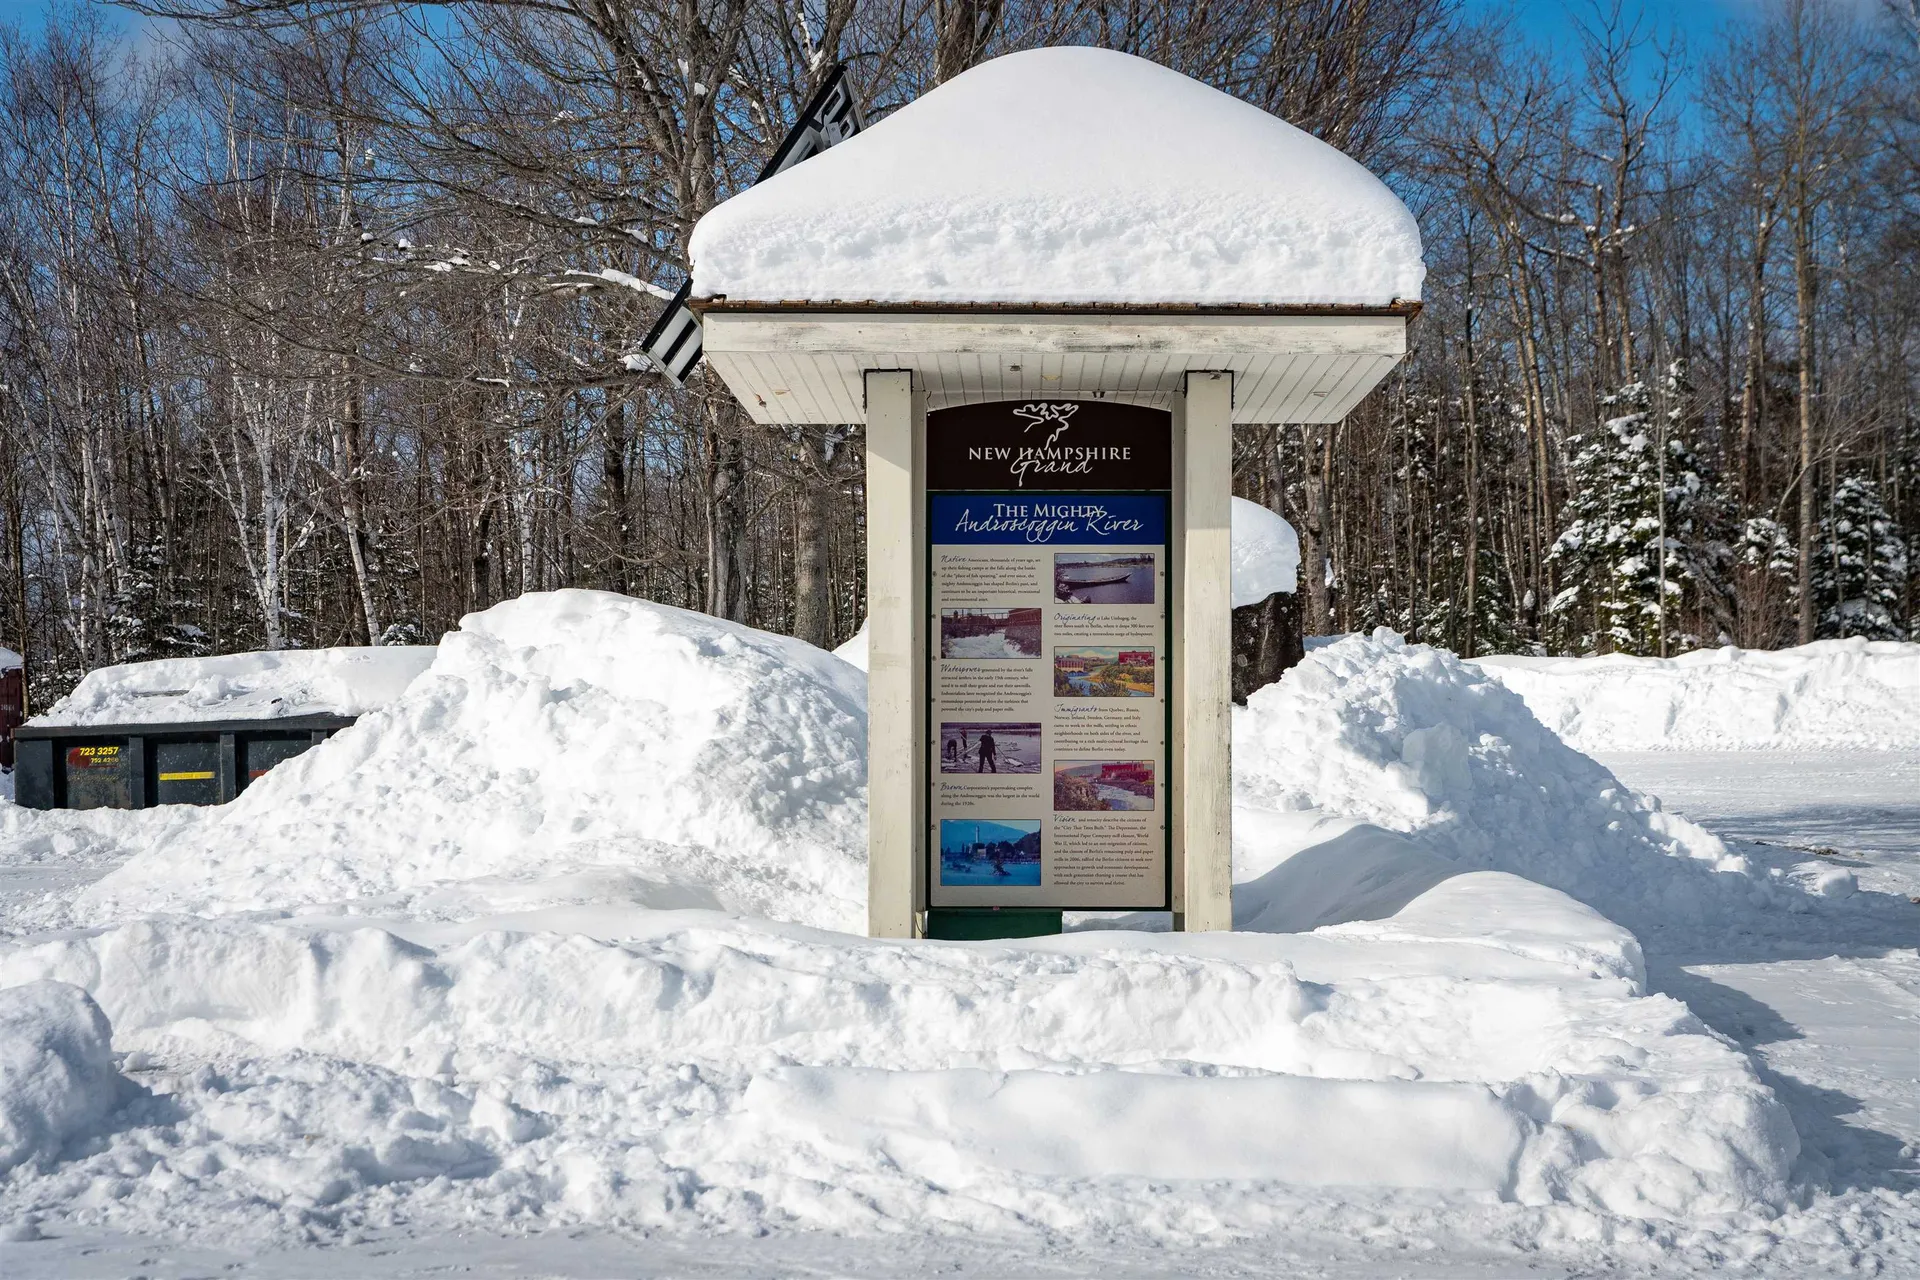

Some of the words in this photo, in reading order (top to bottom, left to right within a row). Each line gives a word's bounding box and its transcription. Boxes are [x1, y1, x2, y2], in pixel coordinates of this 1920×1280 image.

[969, 447, 1011, 460] NEW
[1019, 447, 1131, 460] HAMPSHIRE
[1010, 449, 1093, 487] Grand
[993, 504, 1028, 517] THE
[955, 508, 1078, 542] Androscoggin
[1085, 510, 1144, 536] River
[1054, 612, 1096, 624] Originating
[80, 748, 95, 756] 723
[97, 746, 119, 755] 3257
[1053, 814, 1076, 822] Vision
